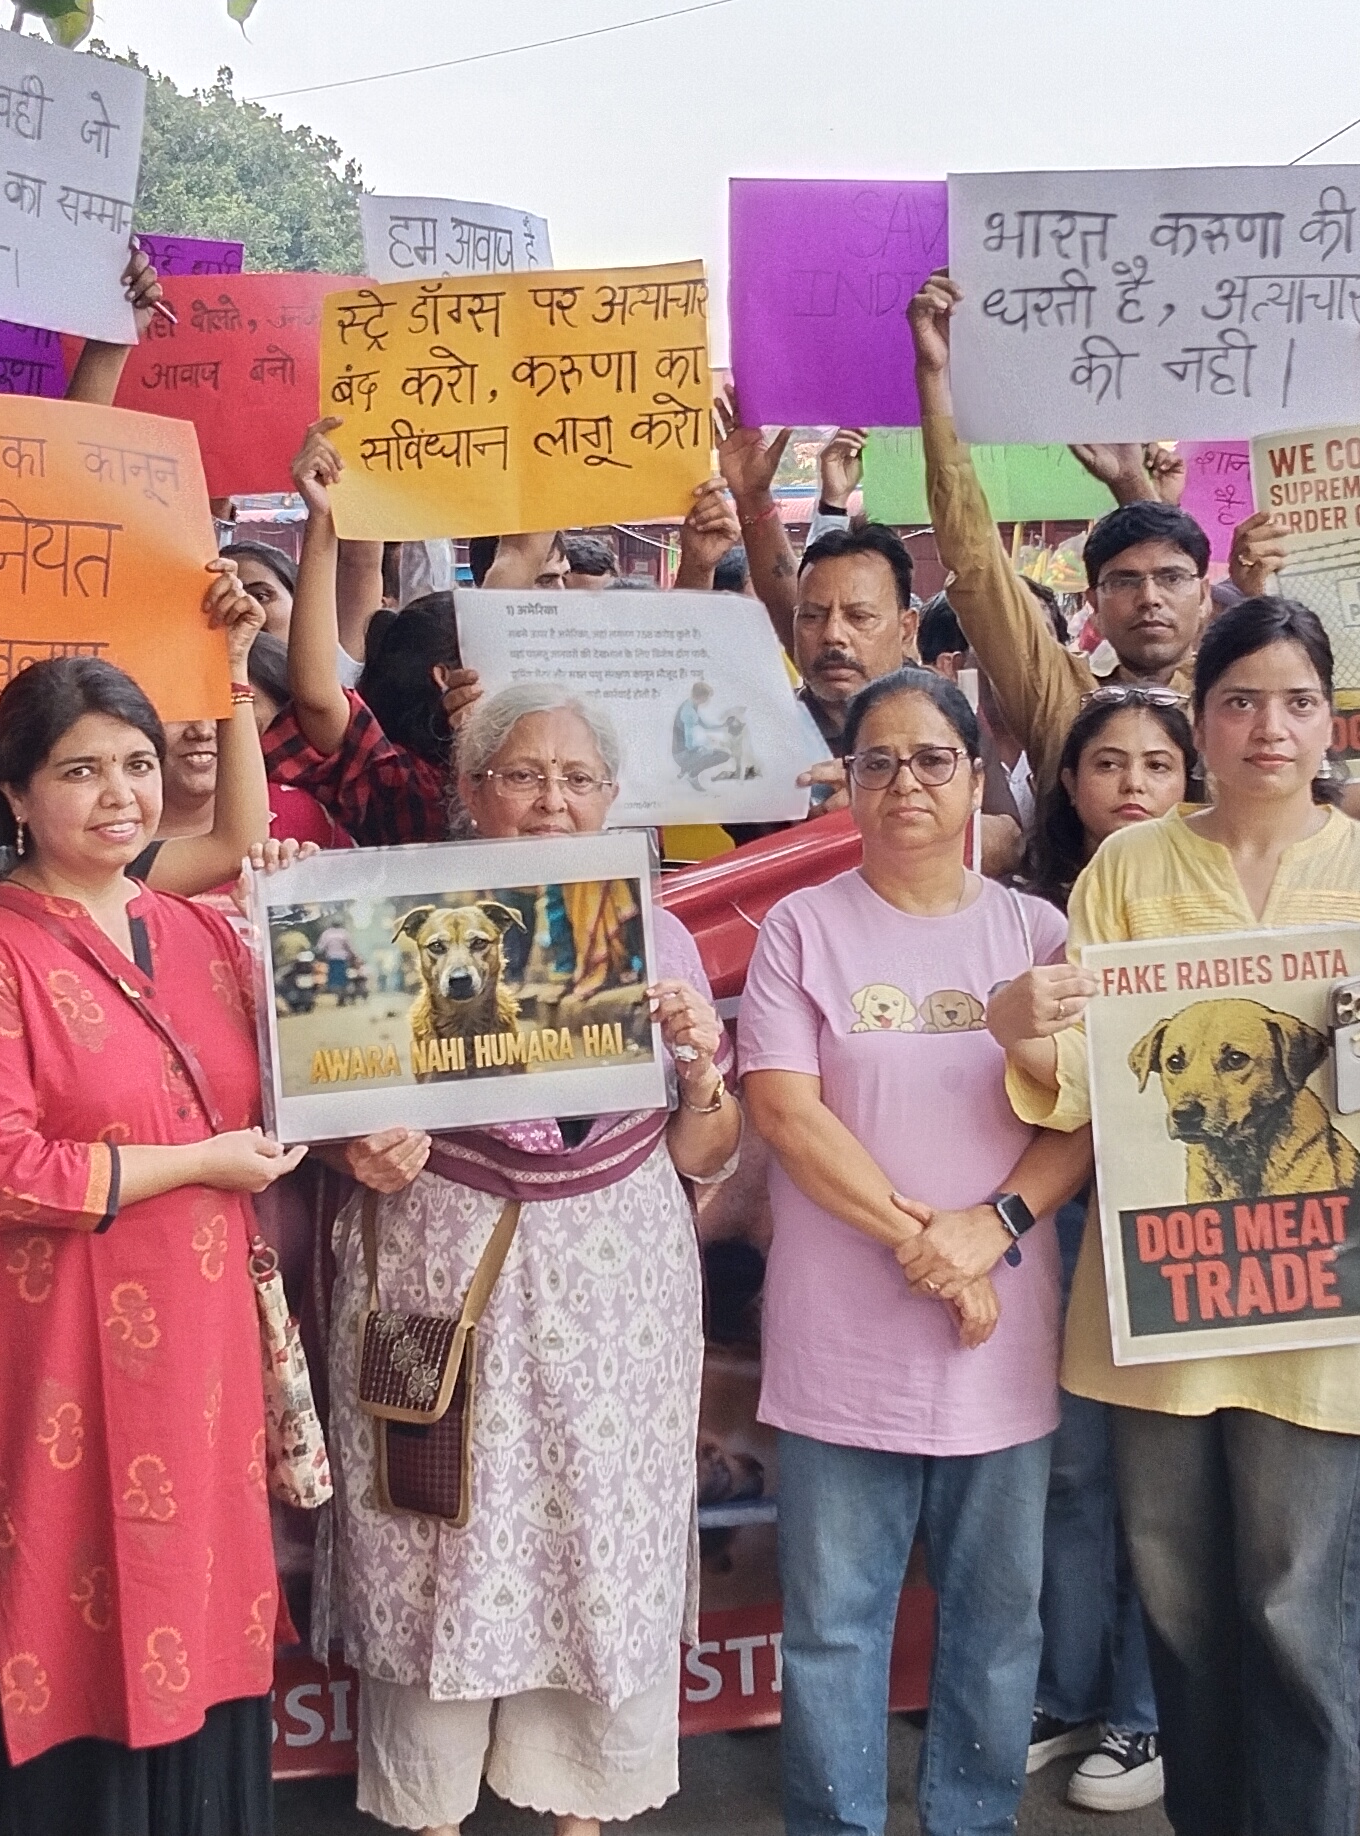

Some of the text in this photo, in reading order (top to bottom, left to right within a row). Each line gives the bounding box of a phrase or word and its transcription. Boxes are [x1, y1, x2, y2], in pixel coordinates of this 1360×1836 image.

[81, 92, 120, 158] जो
[4, 170, 46, 217] का
[389, 216, 437, 268] हम
[849, 190, 946, 258] SAV
[985, 209, 1117, 268] भारत
[1300, 187, 1354, 260] की
[528, 287, 584, 328] पर
[792, 271, 919, 317] INDI
[656, 346, 705, 389] का
[1070, 336, 1139, 405] की
[1, 435, 46, 478] का
[1268, 443, 1317, 479] WE
[1101, 948, 1350, 997] FAKE RABIES DATA
[309, 1022, 625, 1085] AWARA NAHI HUMARA HAI
[1135, 1196, 1351, 1265] DOG MEAT
[1160, 1249, 1342, 1325] TRADE
